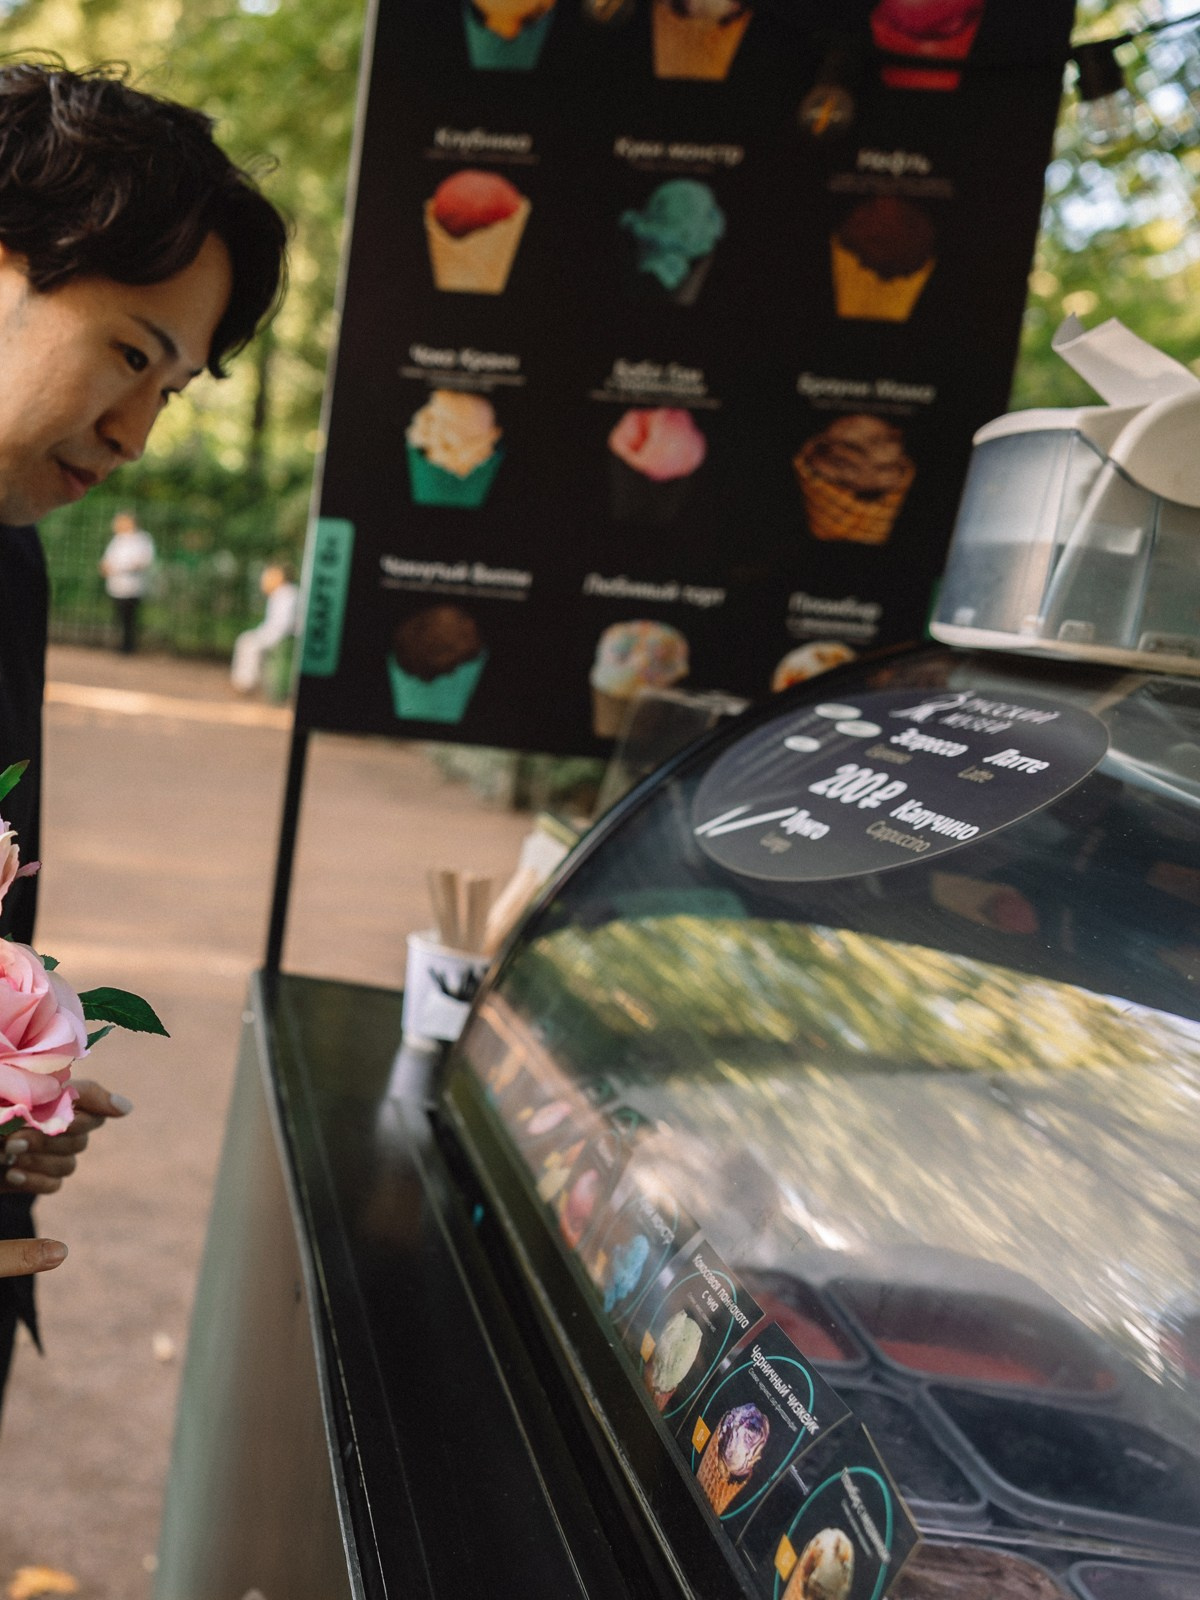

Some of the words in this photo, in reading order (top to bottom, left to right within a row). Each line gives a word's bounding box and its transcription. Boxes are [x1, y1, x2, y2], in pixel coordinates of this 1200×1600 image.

[982, 748, 1049, 774] Латте
[889, 799, 980, 840] Капучино
[717, 1288, 749, 1329] паннакота
[750, 1344, 793, 1398] Черничный
[787, 1393, 820, 1435] чизкейк
